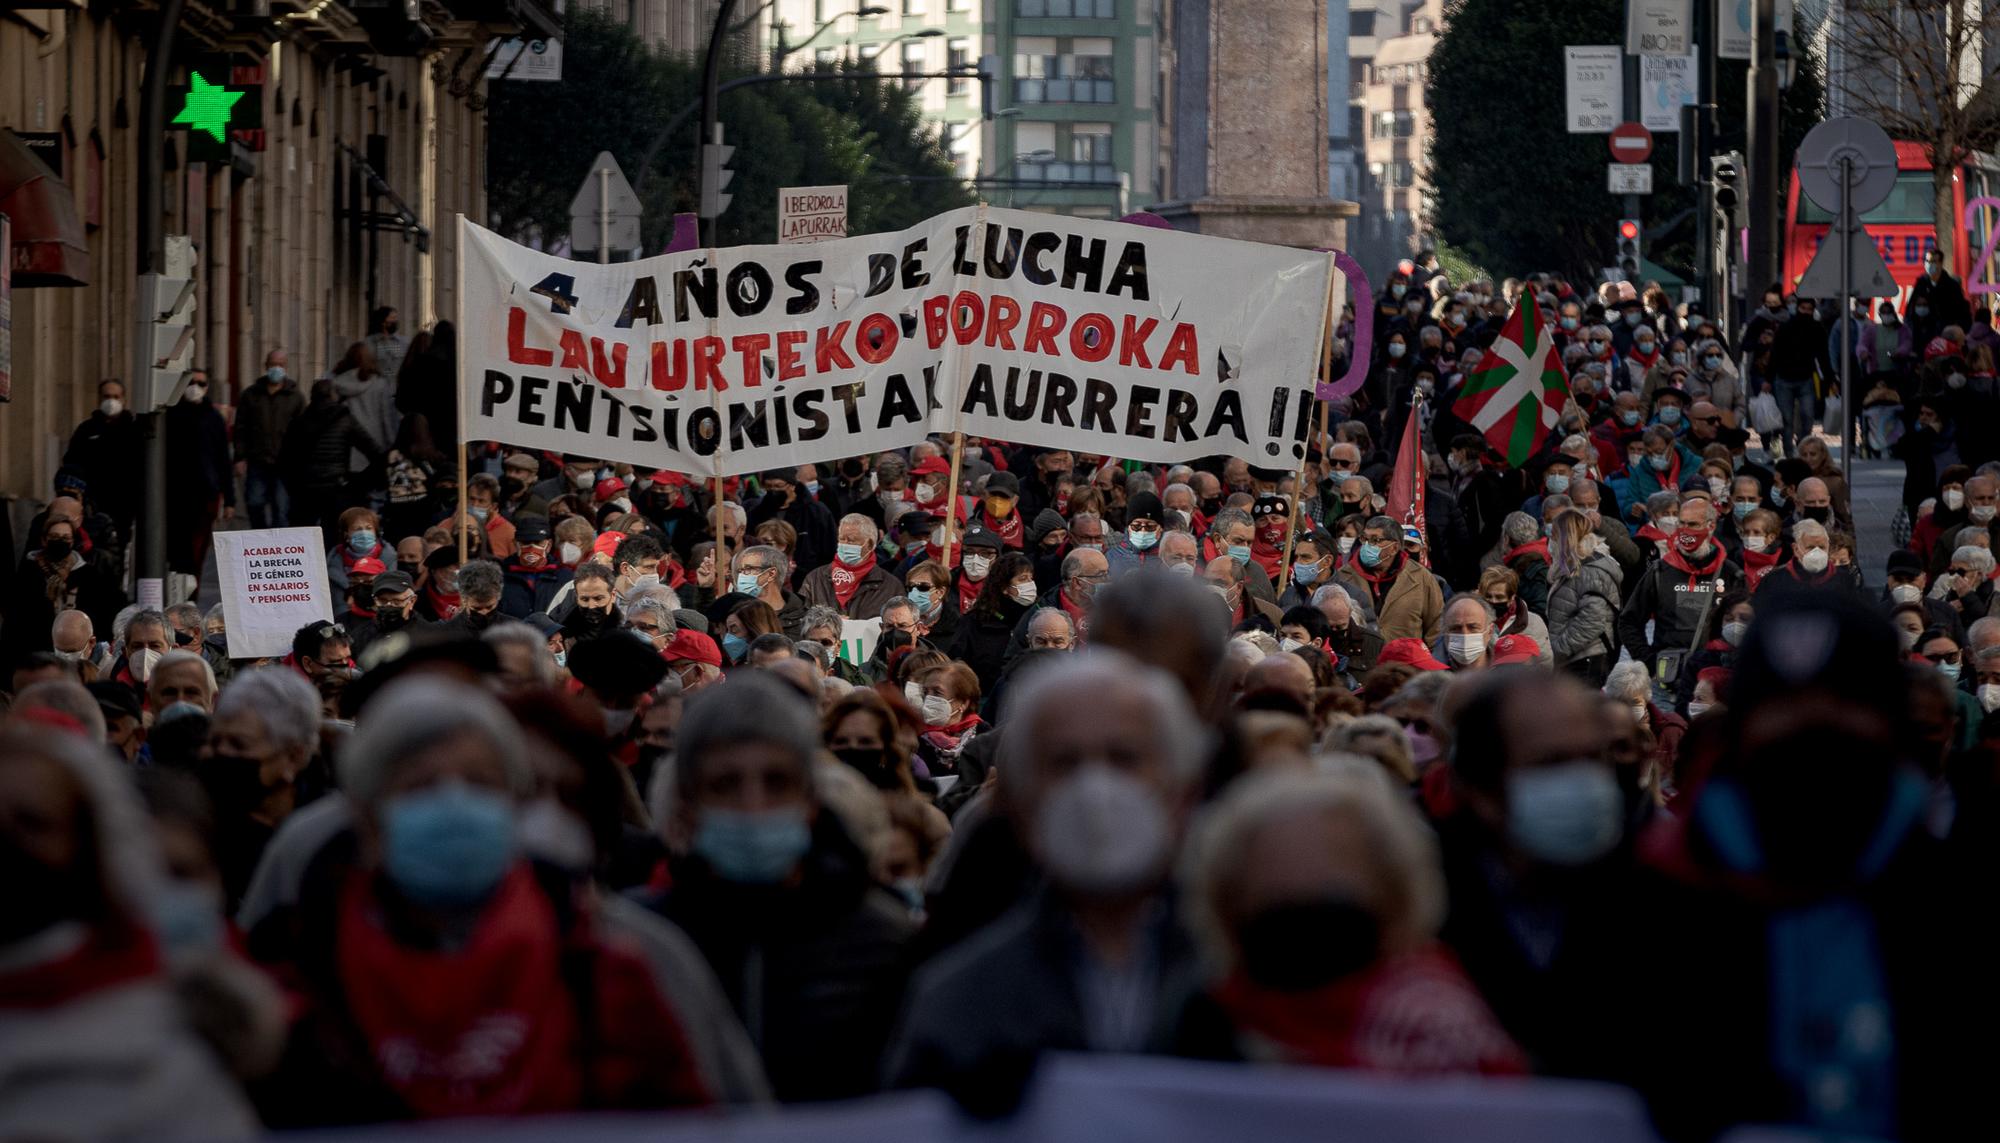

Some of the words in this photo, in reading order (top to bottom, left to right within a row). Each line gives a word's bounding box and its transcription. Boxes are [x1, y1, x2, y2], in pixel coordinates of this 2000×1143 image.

[785, 194, 845, 213] IBERDROLA
[782, 216, 848, 238] LAPURRAK
[529, 271, 579, 314] 4
[614, 257, 824, 329] AÑOS
[863, 236, 931, 298] DE
[953, 222, 1150, 302] LUCHA
[507, 306, 629, 389] LAU
[650, 312, 900, 392] URTEKO
[923, 289, 1200, 376] BORROKA
[961, 362, 1249, 445] AURRERA
[243, 547, 282, 556] ACABAR
[284, 546, 305, 554] CON
[249, 560, 261, 568] LA
[263, 558, 302, 567] BRECHA
[250, 572, 262, 580] DE
[265, 569, 304, 579] GÉNERO
[248, 583, 261, 592] EN
[263, 582, 309, 591] SALARIOS
[249, 596, 256, 604] Y
[258, 593, 311, 604] PENSIONES
